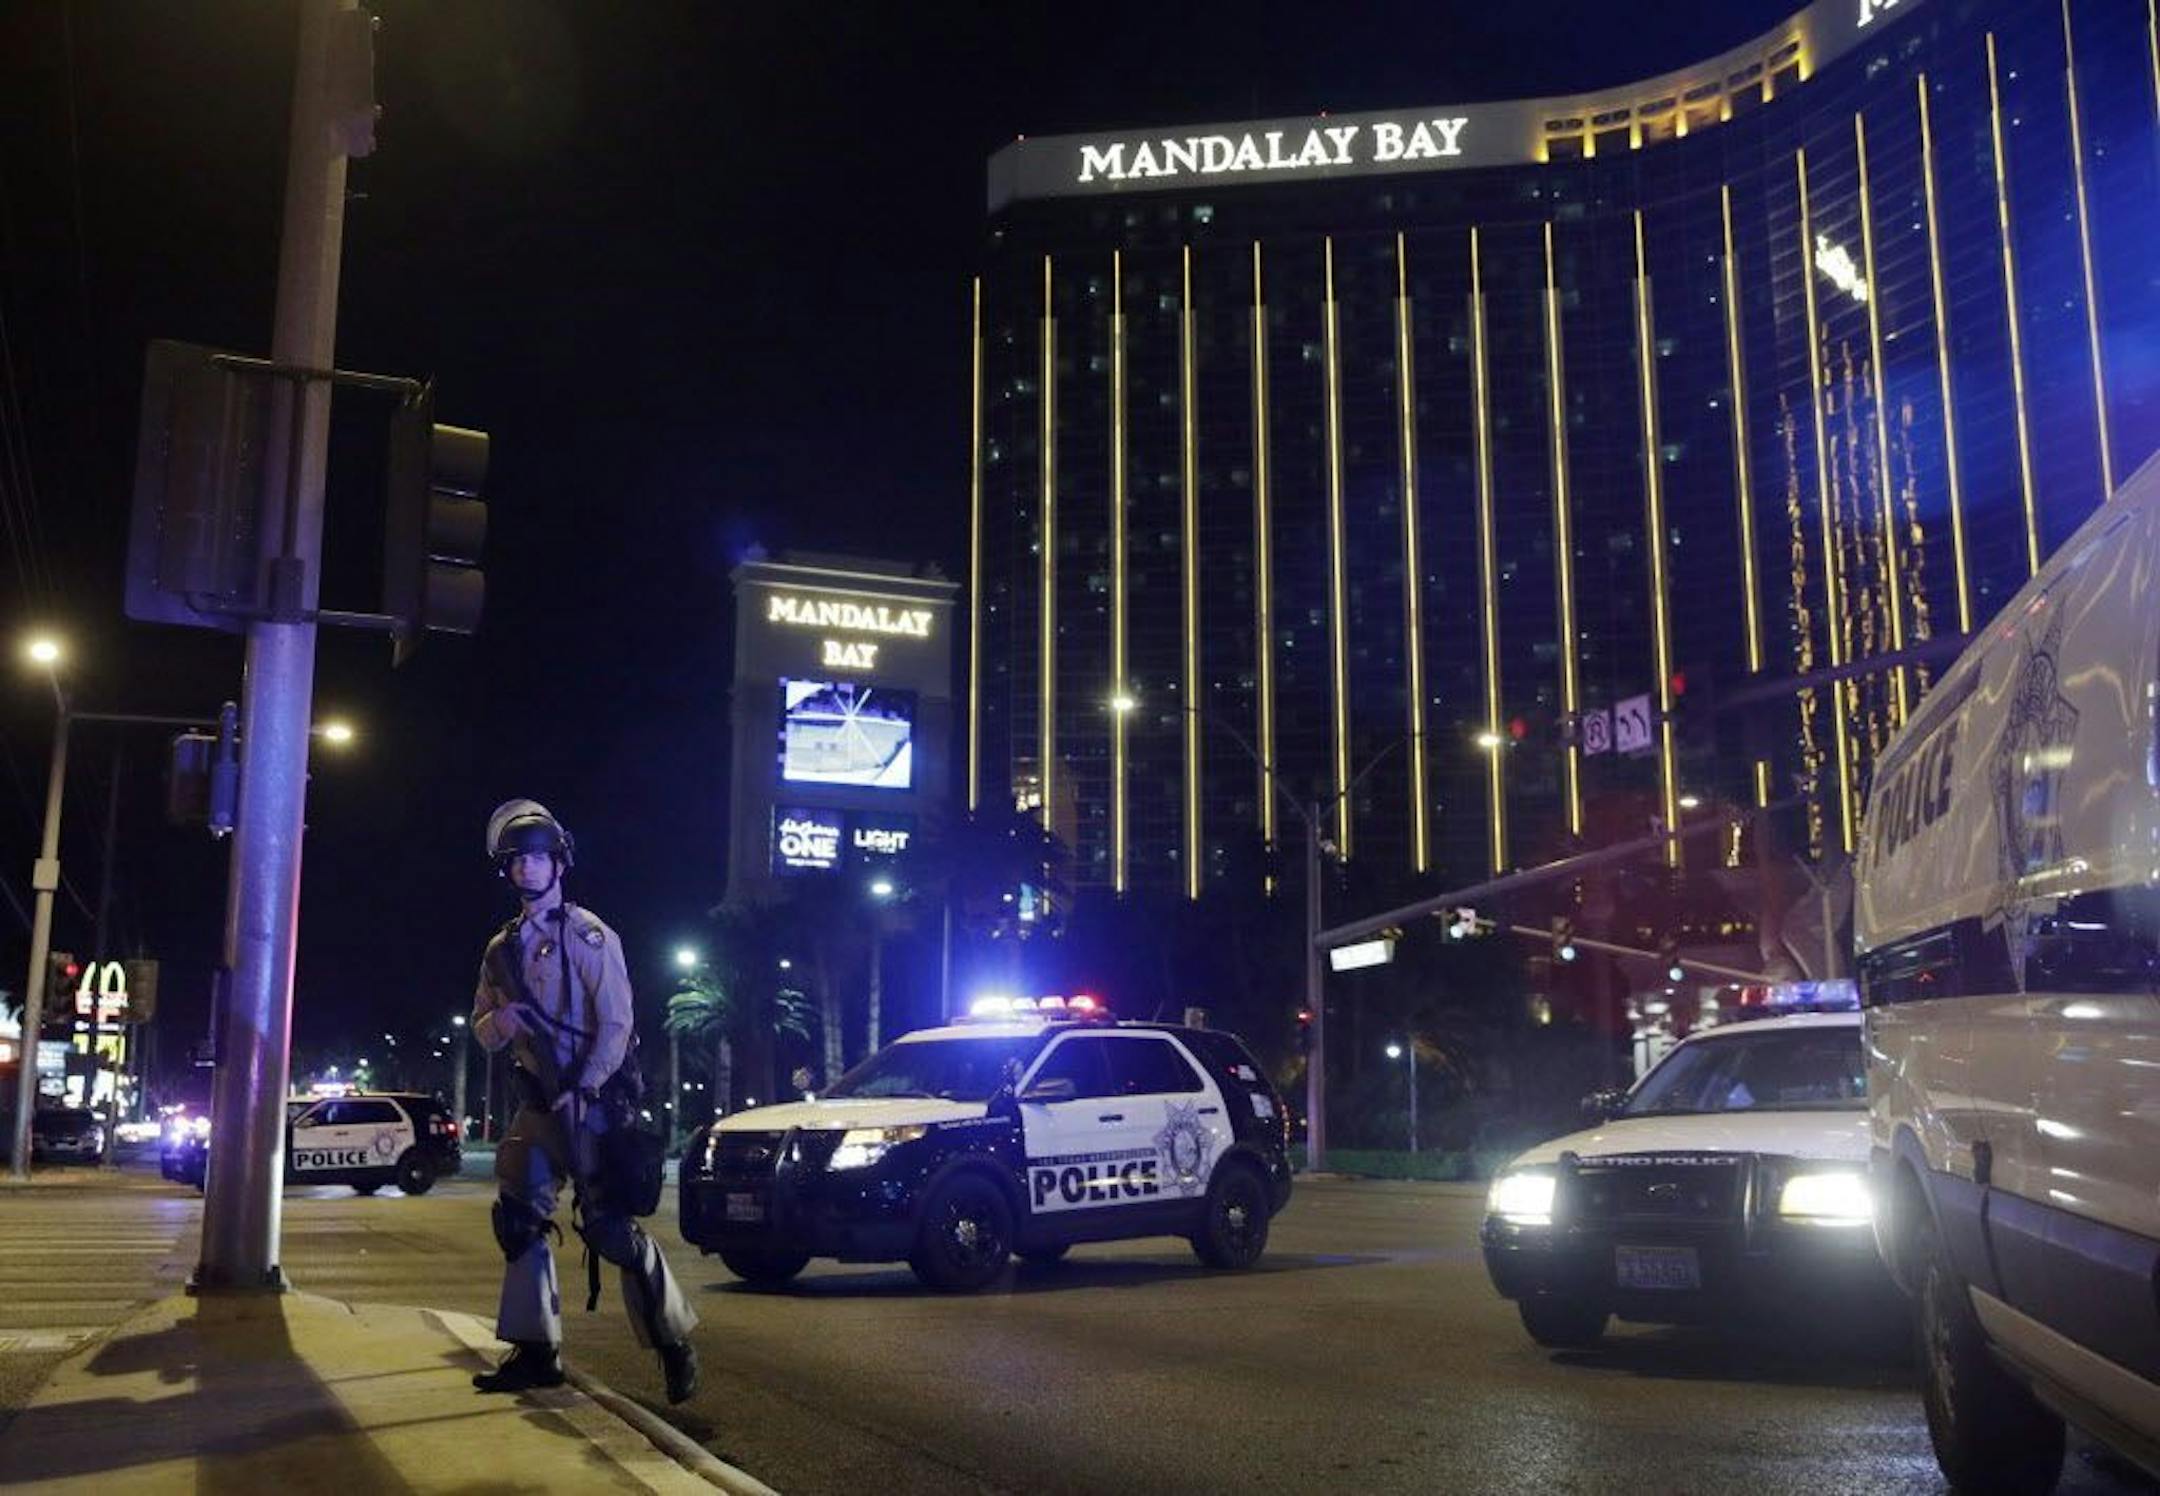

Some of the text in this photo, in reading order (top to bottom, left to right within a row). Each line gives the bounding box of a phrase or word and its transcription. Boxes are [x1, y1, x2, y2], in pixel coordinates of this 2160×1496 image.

[1078, 117, 1468, 182] MANDALAY BAY
[768, 596, 932, 636] MANDALAY
[823, 640, 878, 668] BAY
[1874, 720, 1959, 867] POLICE
[780, 835, 837, 858] ONE
[854, 828, 909, 850] LIGHT
[297, 1152, 368, 1167] POLICE
[1034, 1161, 1158, 1206] POLICE
